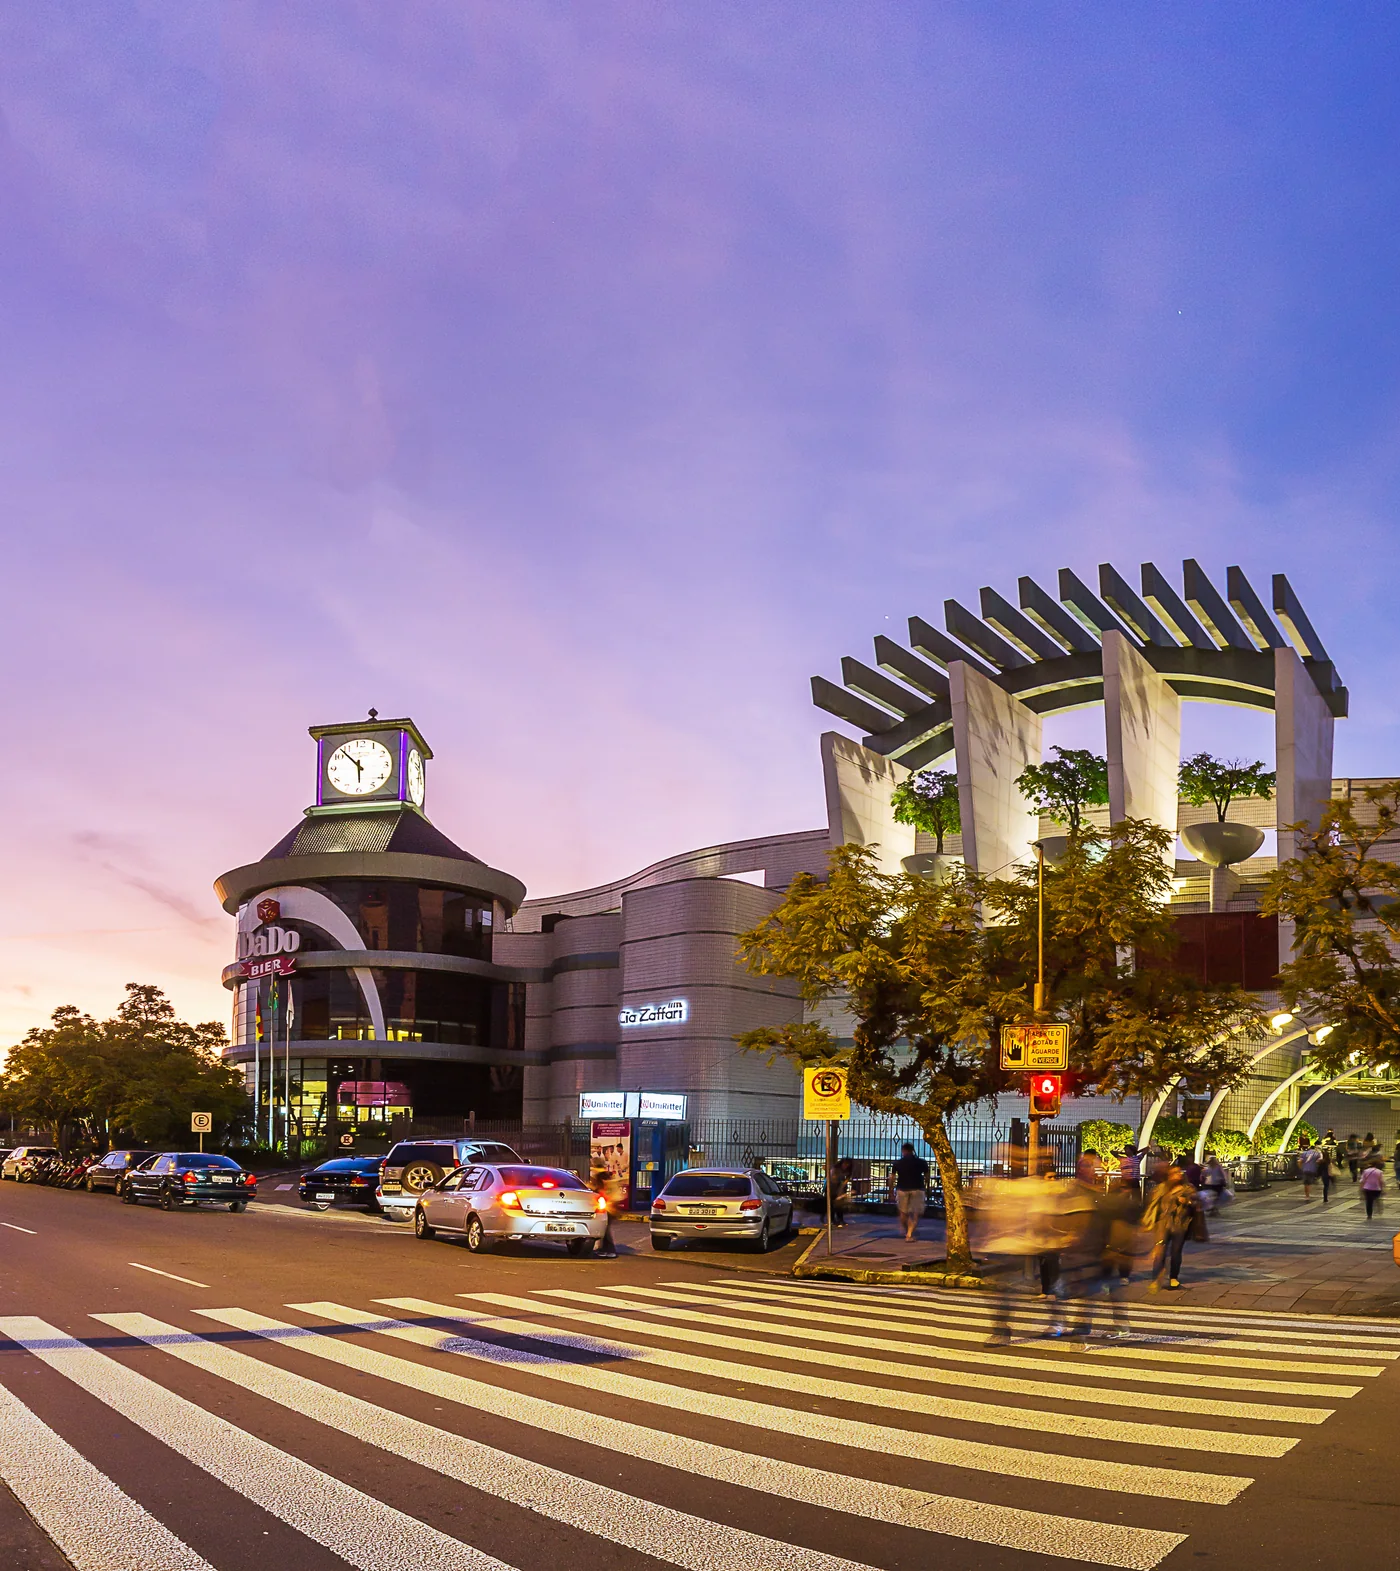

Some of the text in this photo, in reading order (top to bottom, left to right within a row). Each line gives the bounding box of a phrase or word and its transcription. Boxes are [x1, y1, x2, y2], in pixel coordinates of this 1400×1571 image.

[238, 926, 300, 960] DaDo
[251, 958, 281, 976] BIER
[620, 1003, 683, 1024] Cia Zaffari
[591, 1101, 623, 1109] UniRitter
[649, 1101, 682, 1111] UniRitter
